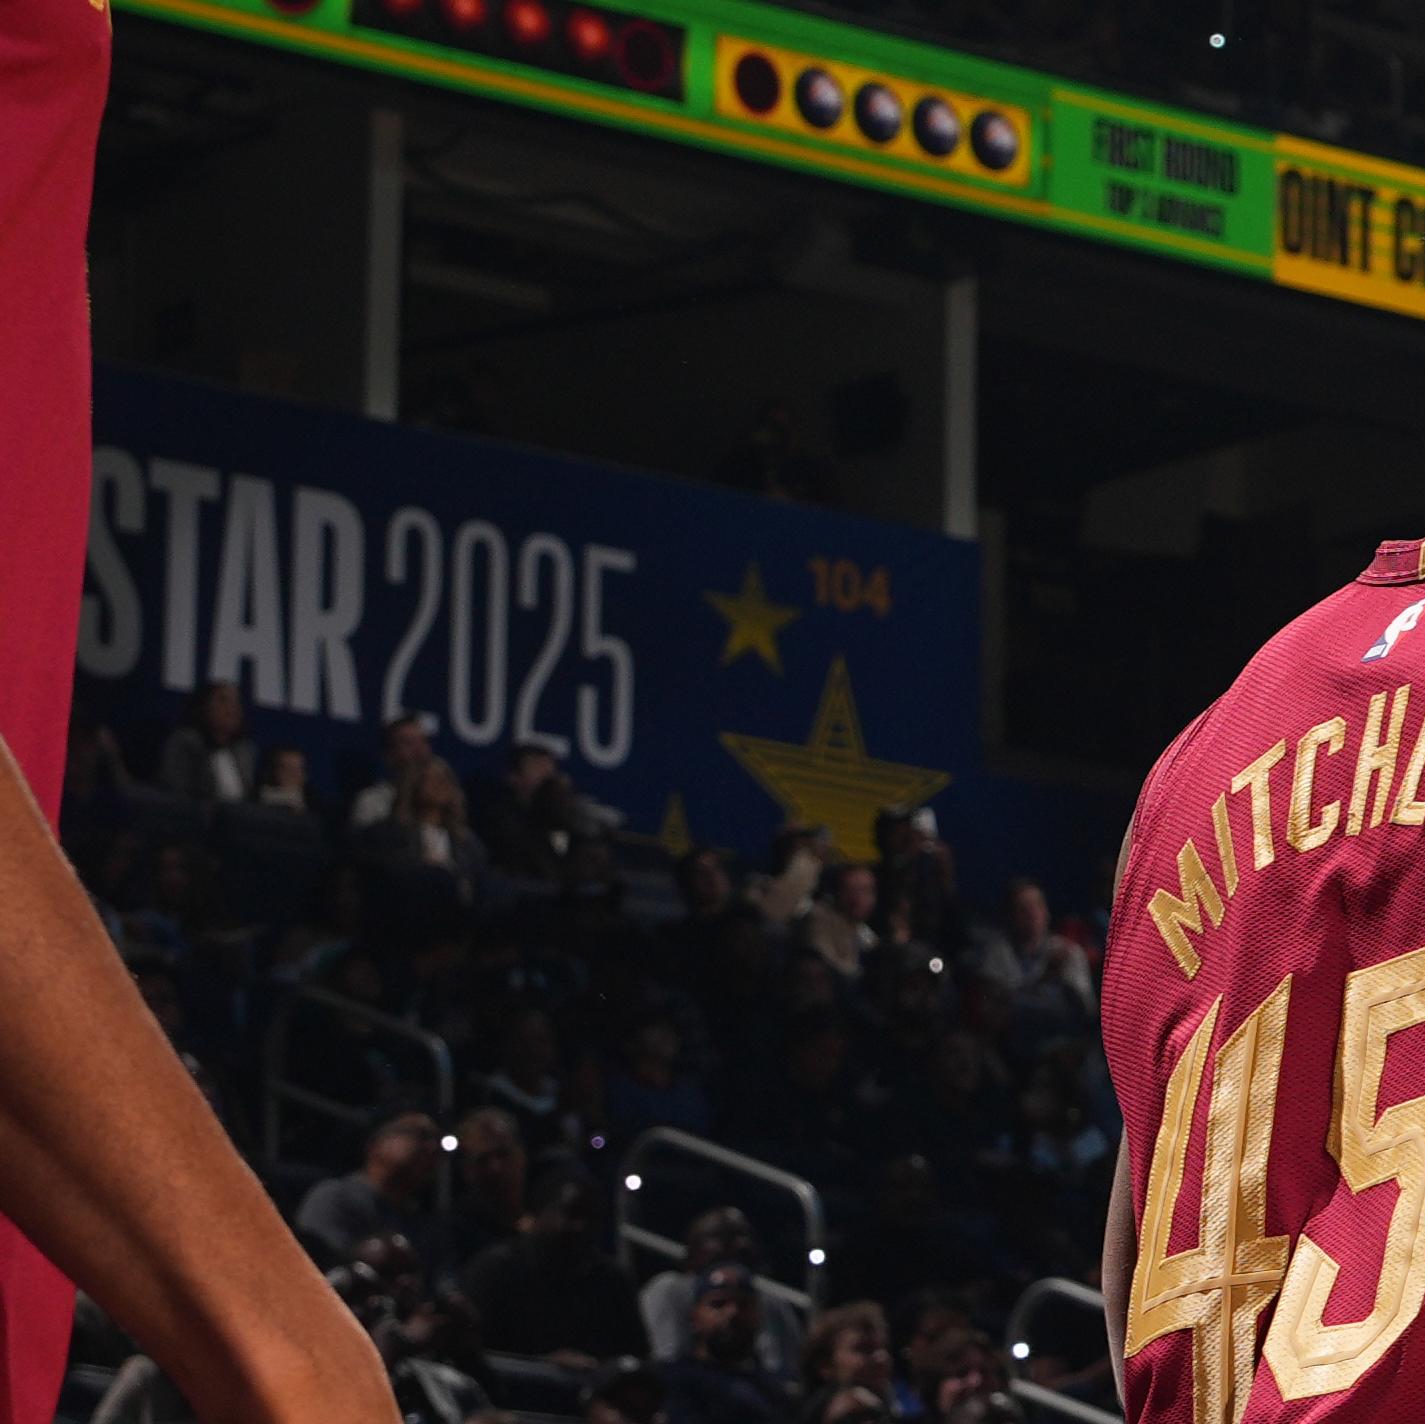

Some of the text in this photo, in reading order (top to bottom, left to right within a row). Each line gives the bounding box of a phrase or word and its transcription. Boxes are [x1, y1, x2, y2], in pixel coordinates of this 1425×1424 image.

[77, 445, 638, 769] STAR 2025
[805, 556, 891, 616] 104
